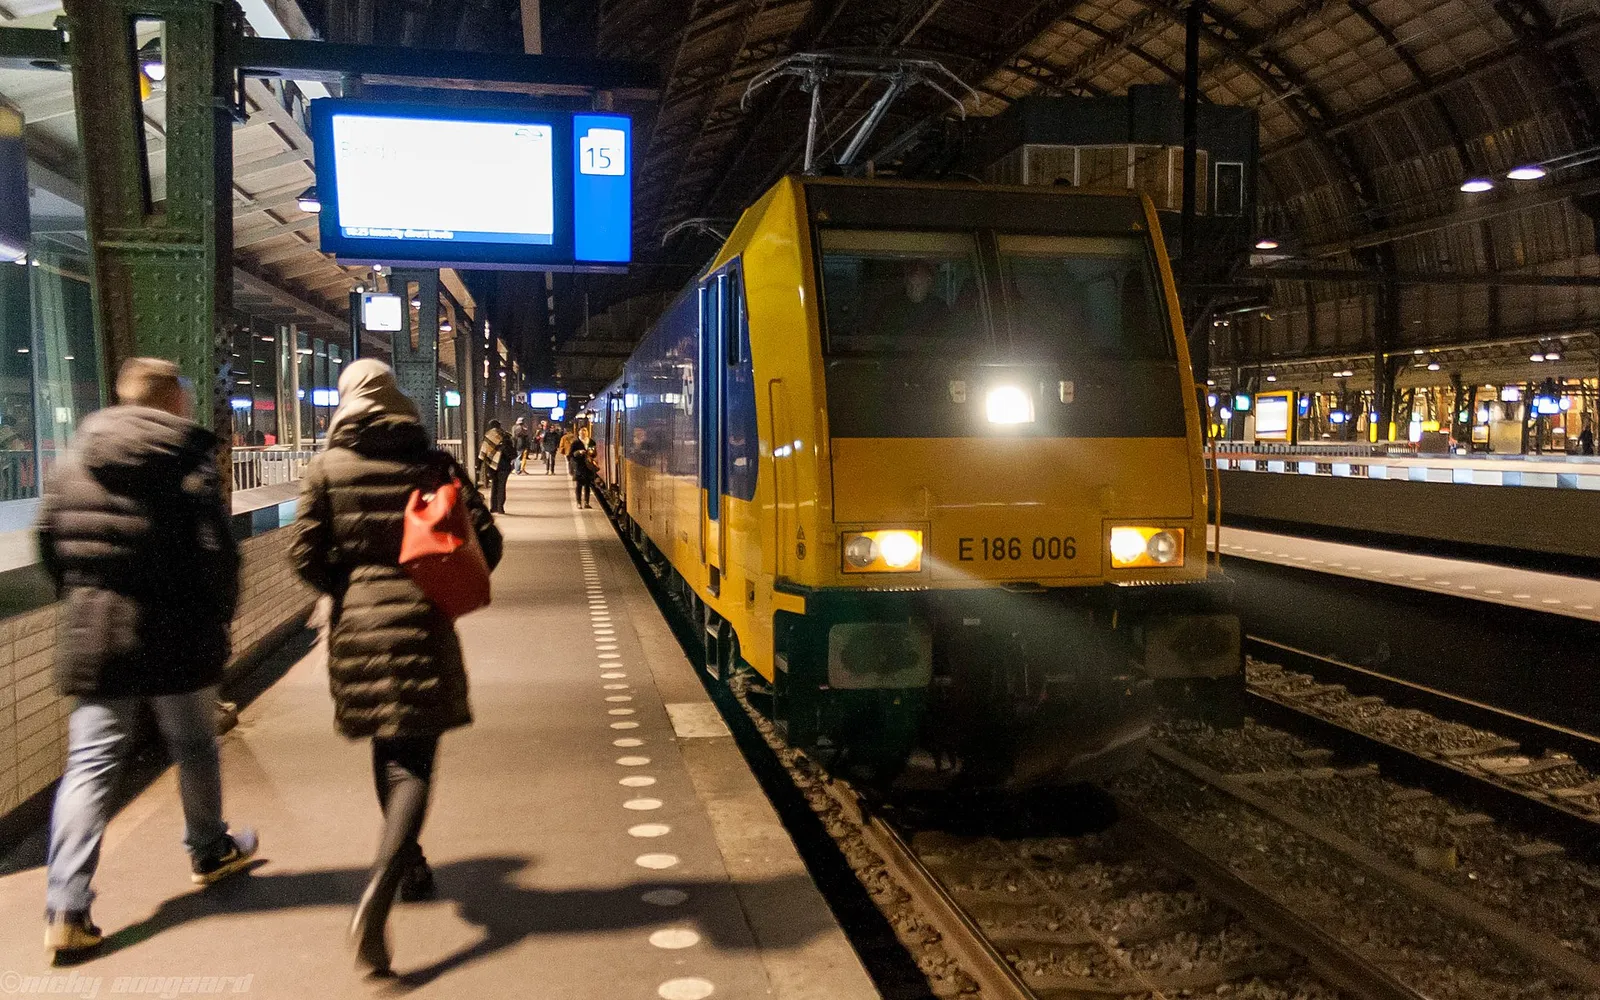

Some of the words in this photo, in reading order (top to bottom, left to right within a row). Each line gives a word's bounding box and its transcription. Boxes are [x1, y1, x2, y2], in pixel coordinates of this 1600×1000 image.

[958, 537, 974, 561] E
[981, 537, 1022, 561] 186
[1032, 536, 1077, 560] 006
